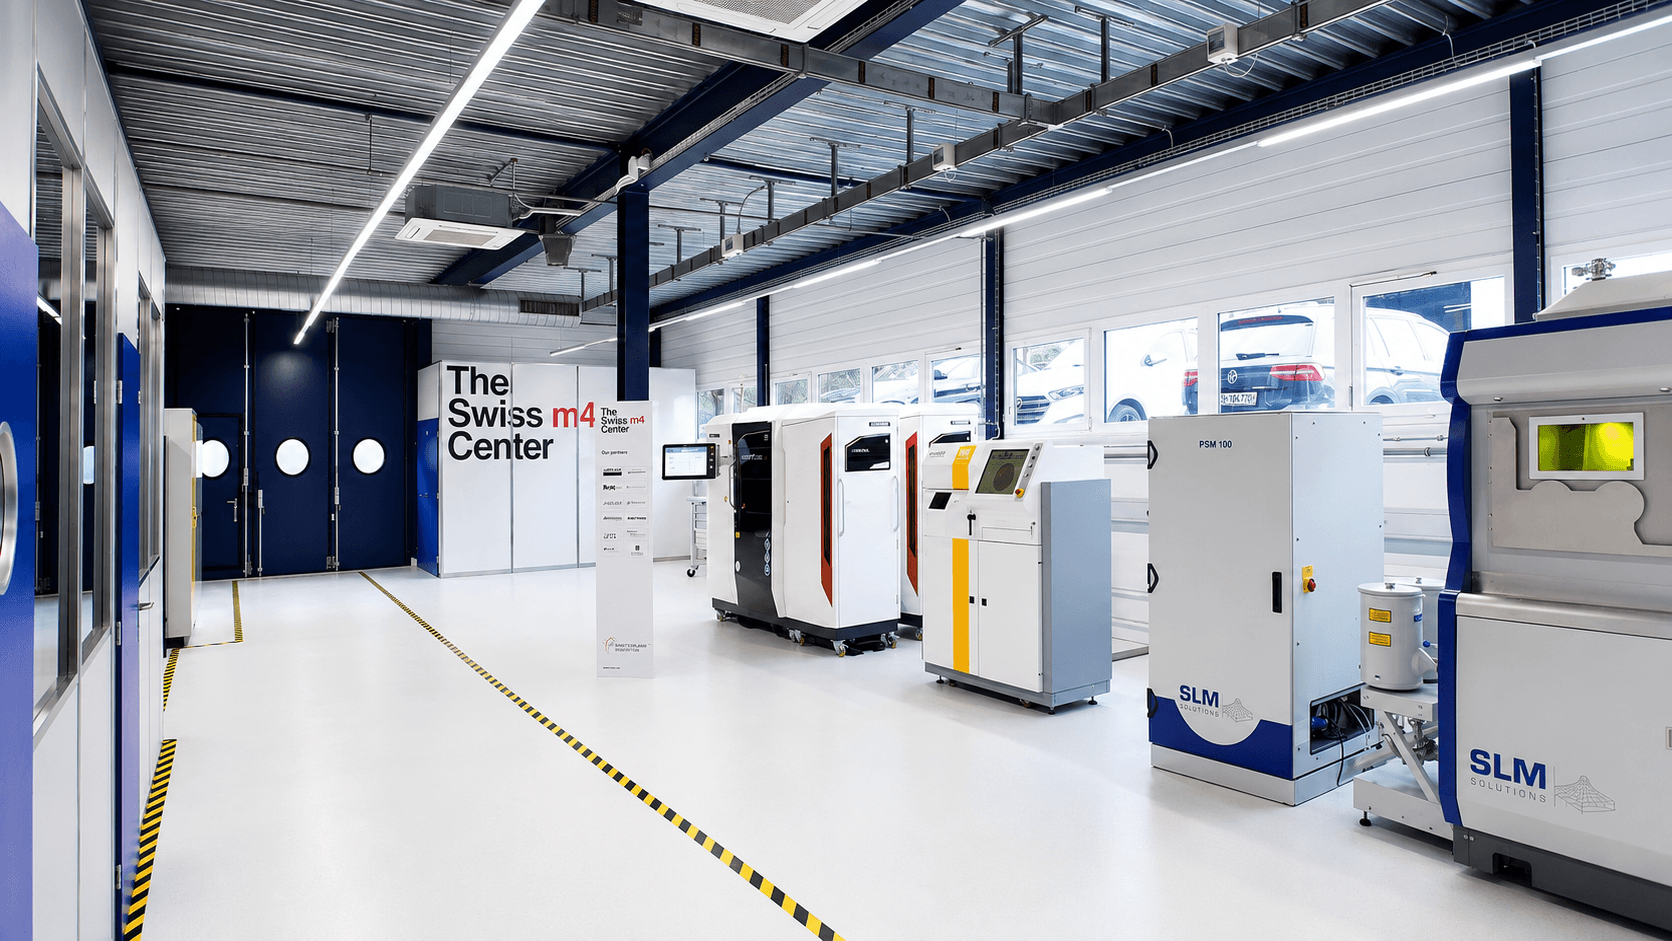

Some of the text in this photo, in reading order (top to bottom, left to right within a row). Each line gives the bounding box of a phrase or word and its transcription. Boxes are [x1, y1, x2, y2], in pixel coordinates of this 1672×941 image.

[447, 365, 509, 396] The
[448, 398, 595, 428] Swiss m4
[601, 407, 617, 416] The
[601, 415, 645, 425] Swiss m4
[601, 425, 629, 433] Center
[448, 431, 554, 460] Center
[1199, 440, 1232, 448] PSM 100
[1179, 684, 1219, 708] SLM
[1179, 703, 1219, 717] SOLUTIONS
[1470, 748, 1546, 790] SLM
[1470, 777, 1547, 803] SOLUTIONS
